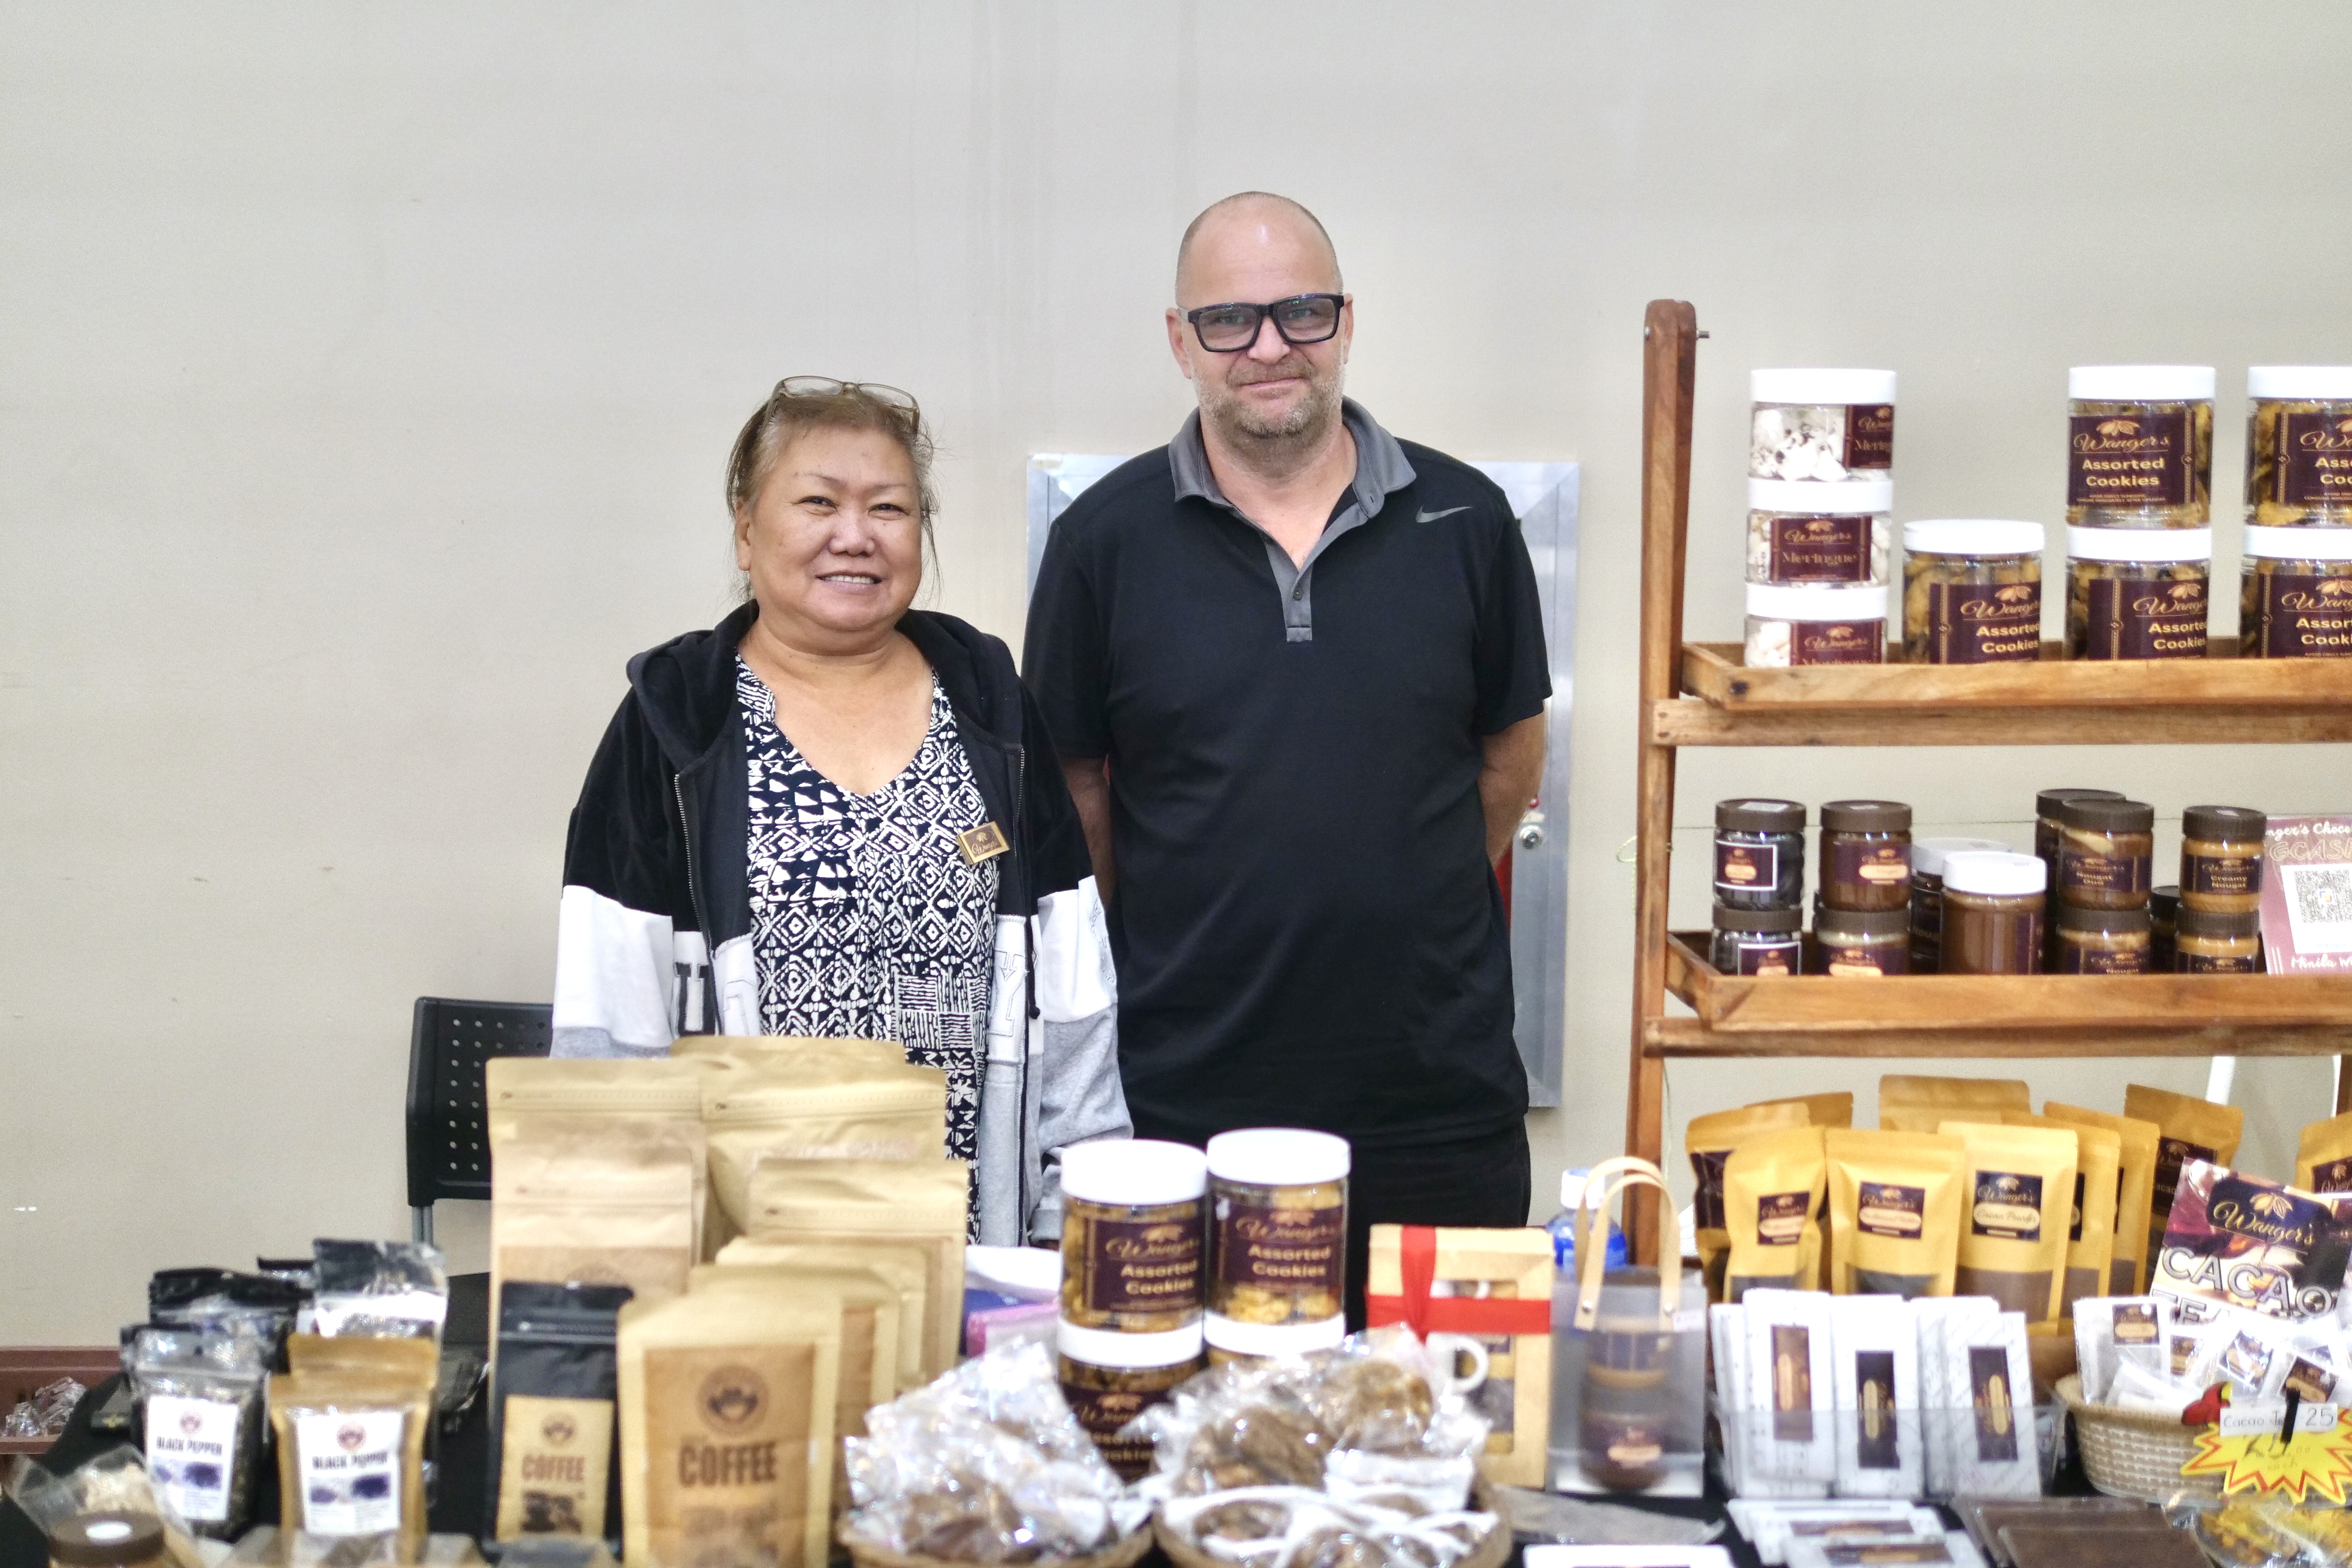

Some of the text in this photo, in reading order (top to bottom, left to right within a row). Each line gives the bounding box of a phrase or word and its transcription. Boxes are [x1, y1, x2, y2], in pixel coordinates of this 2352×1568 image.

[2082, 458, 2166, 470] Assorted
[2315, 457, 2352, 468] Ass
[2086, 475, 2161, 486] Cookies
[2214, 1200, 2313, 1246] Wanger's
[1249, 1245, 1332, 1260] Assorted
[1121, 1259, 1198, 1278] Assorted
[1252, 1261, 1326, 1277] Cookies
[1125, 1279, 1195, 1295] Cookies
[2162, 1246, 2333, 1318] CACAO
[2305, 1406, 2333, 1427] 25
[521, 1454, 585, 1483] COFFEE
[678, 1441, 777, 1489] COFFEE
